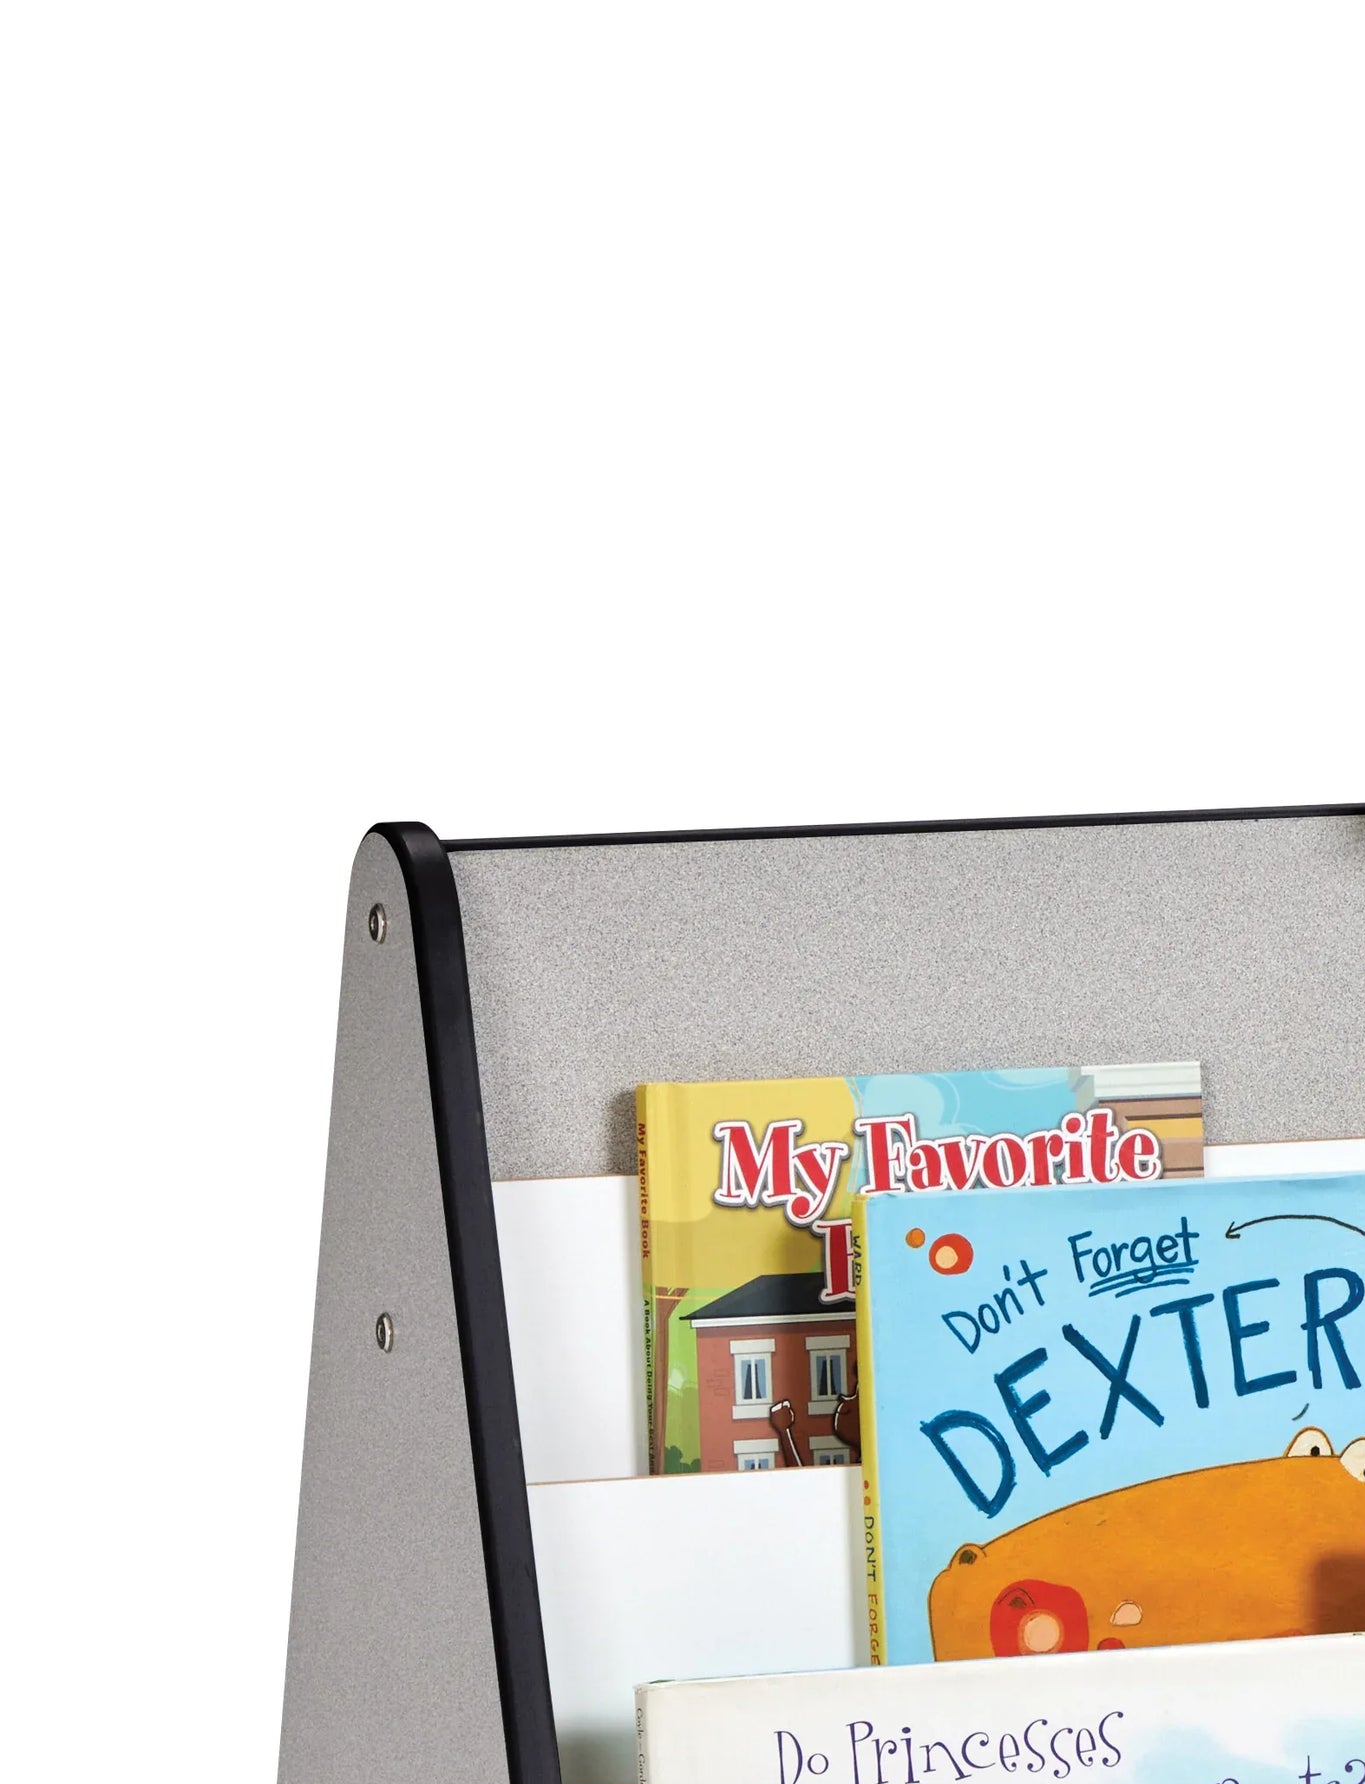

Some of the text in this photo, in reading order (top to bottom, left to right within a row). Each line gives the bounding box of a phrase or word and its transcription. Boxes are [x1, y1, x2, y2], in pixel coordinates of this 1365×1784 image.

[637, 1124, 646, 1145] My
[642, 1220, 650, 1258] Book
[715, 1109, 1162, 1224] My Favorite
[853, 1236, 862, 1286] WARD
[944, 1217, 1200, 1355] Don't Forget
[864, 1516, 877, 1582] DON'T
